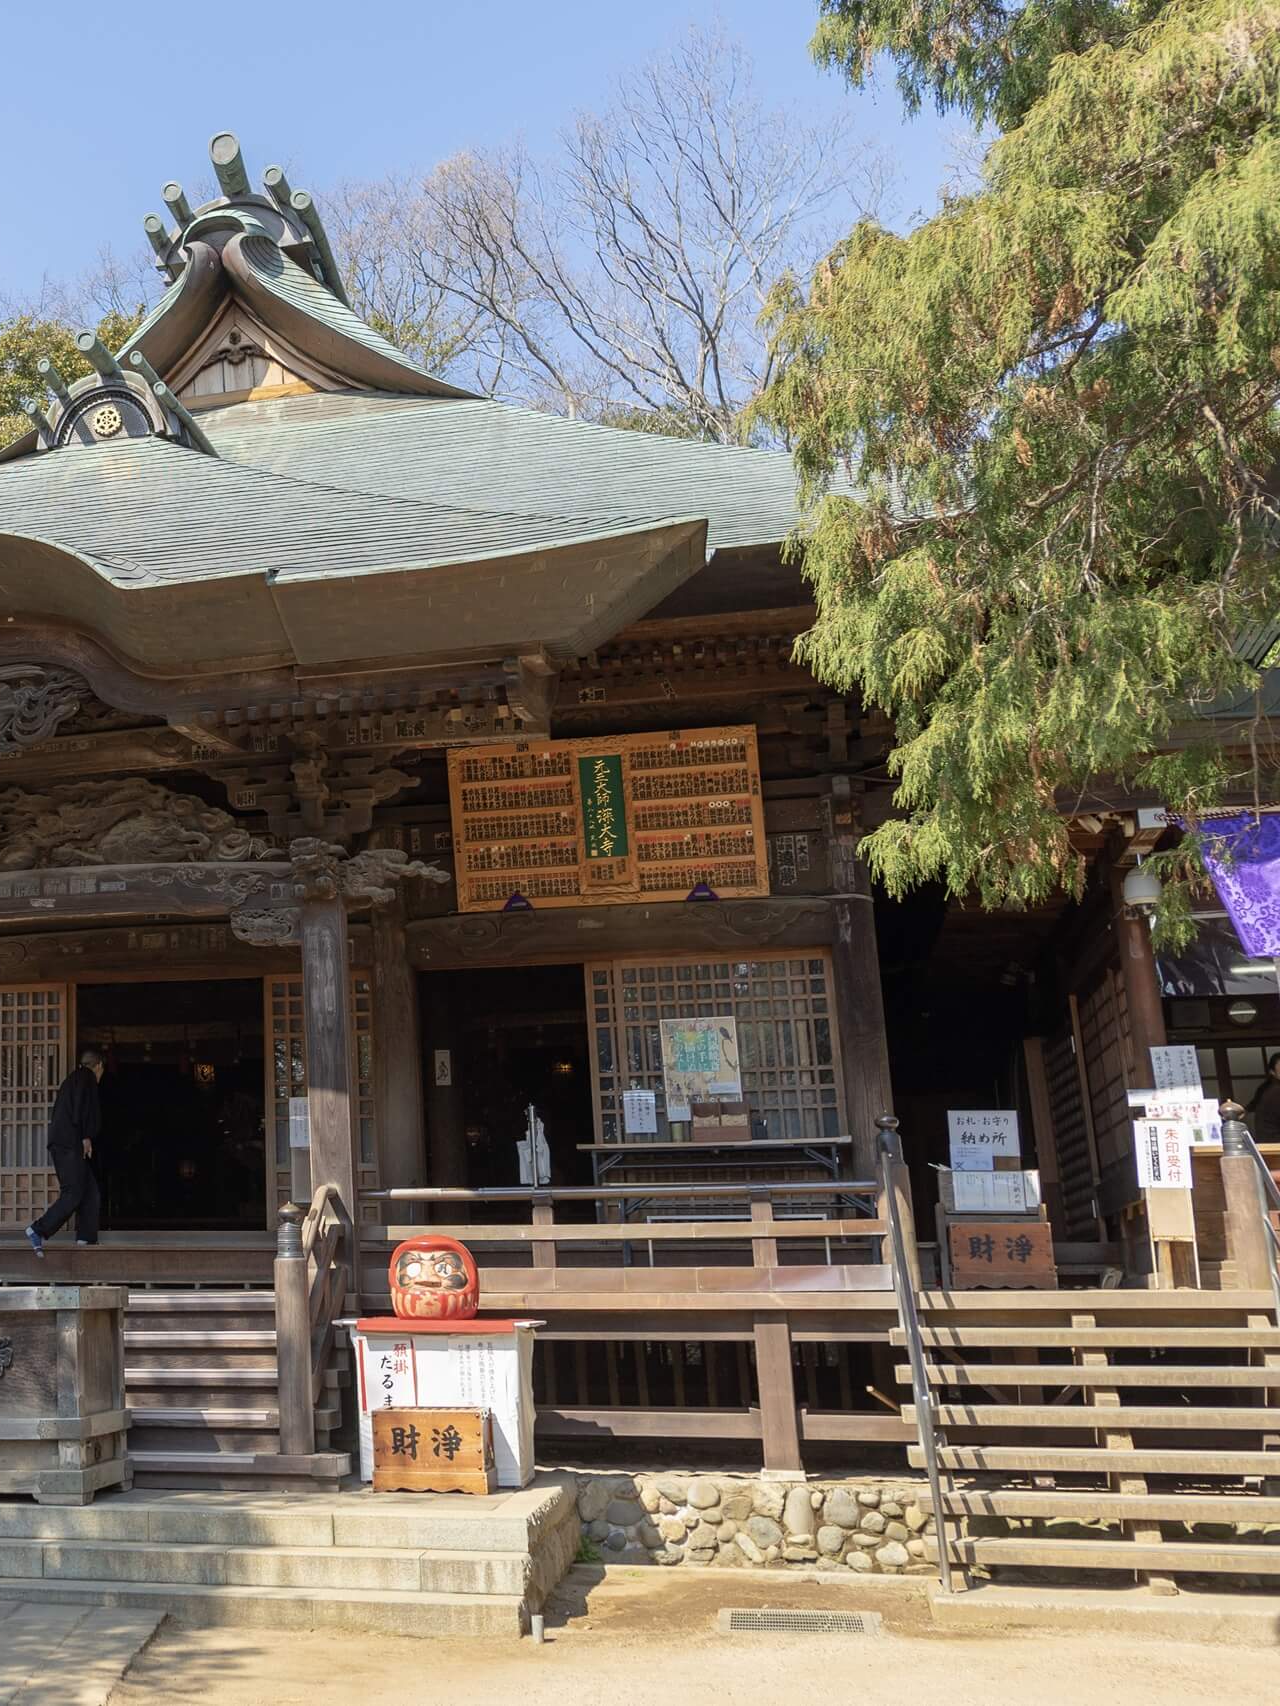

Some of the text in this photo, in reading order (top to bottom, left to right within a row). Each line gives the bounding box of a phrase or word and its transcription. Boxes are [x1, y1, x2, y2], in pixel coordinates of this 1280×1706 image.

[960, 1131, 1008, 1146] 納め所
[1164, 1128, 1184, 1182] 朱印受付
